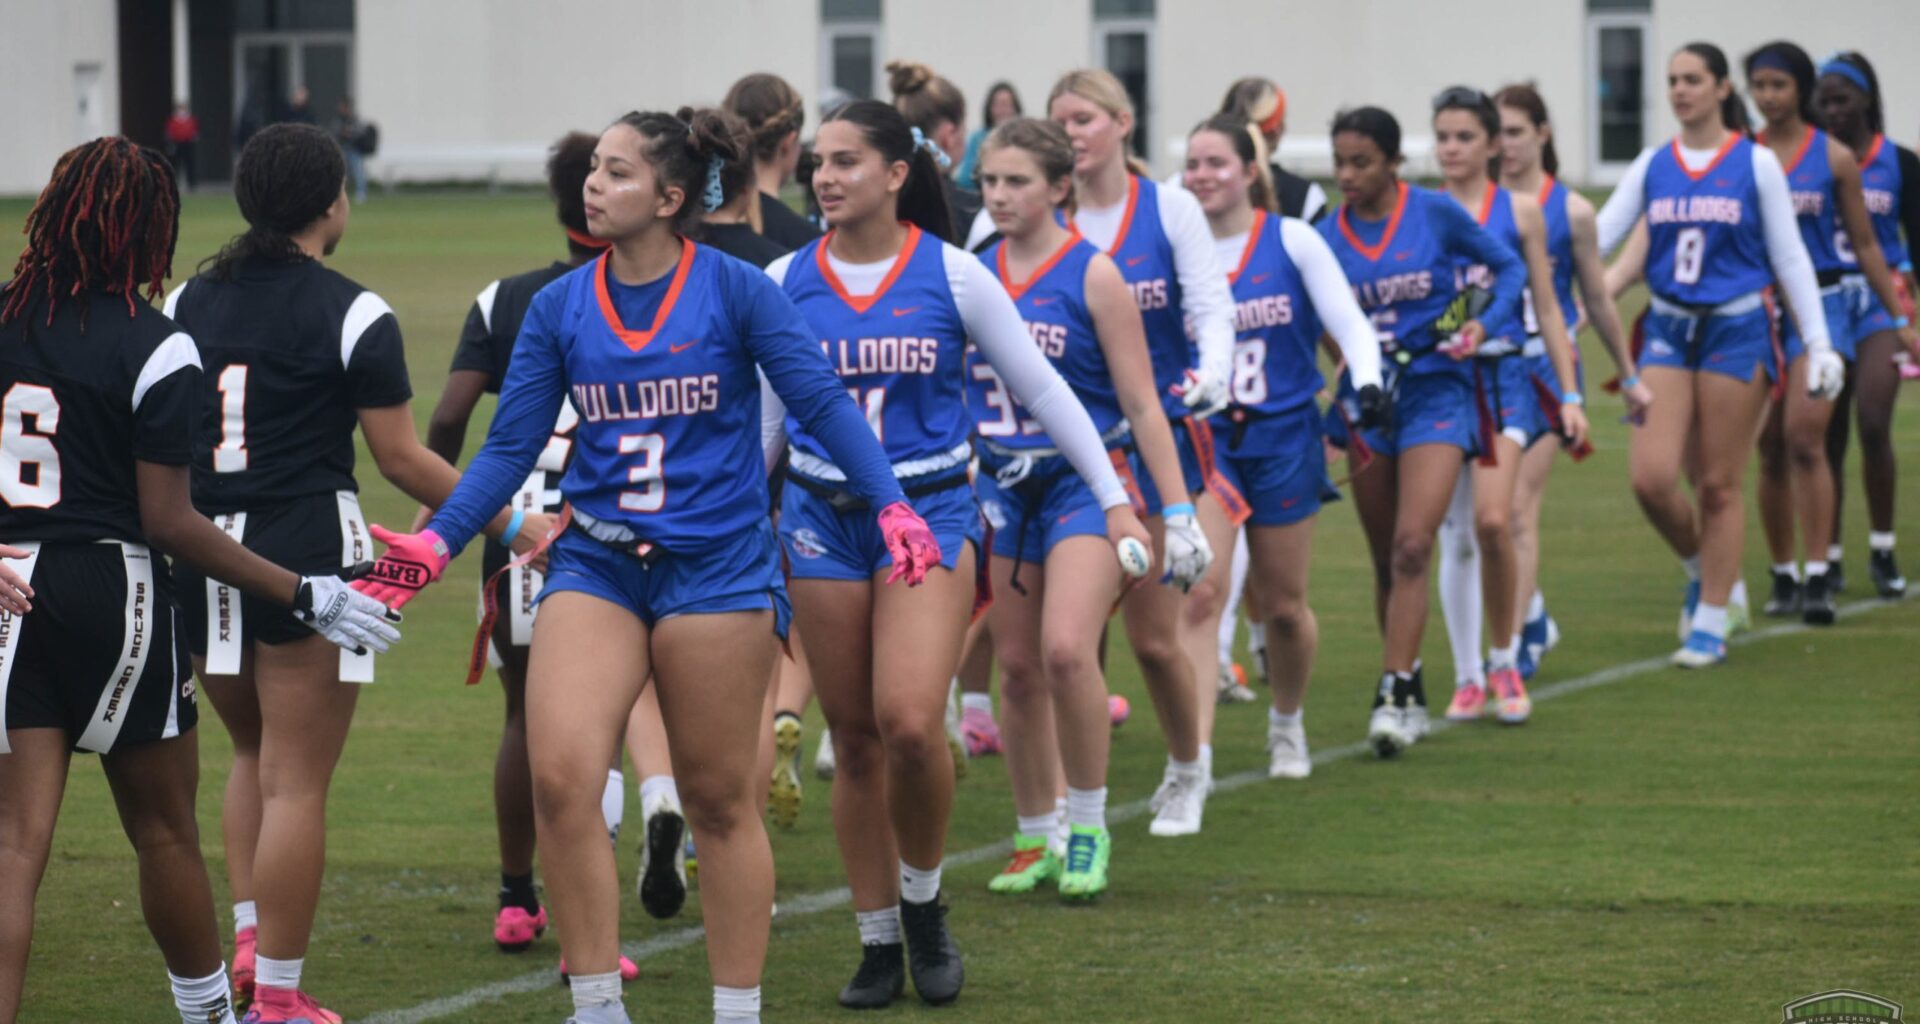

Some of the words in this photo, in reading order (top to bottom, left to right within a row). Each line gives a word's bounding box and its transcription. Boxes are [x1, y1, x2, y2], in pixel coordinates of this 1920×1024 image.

[820, 336, 939, 376] LDOGS
[212, 364, 249, 474] 1
[847, 386, 886, 442] 1
[972, 363, 1045, 437] 3
[0, 381, 62, 510] 6
[618, 432, 665, 513] 3
[348, 519, 364, 562] SPRU
[373, 561, 421, 584] BAT
[130, 581, 145, 659] SPRUCE
[217, 585, 232, 642] CREEK
[102, 665, 135, 723] CREEK
